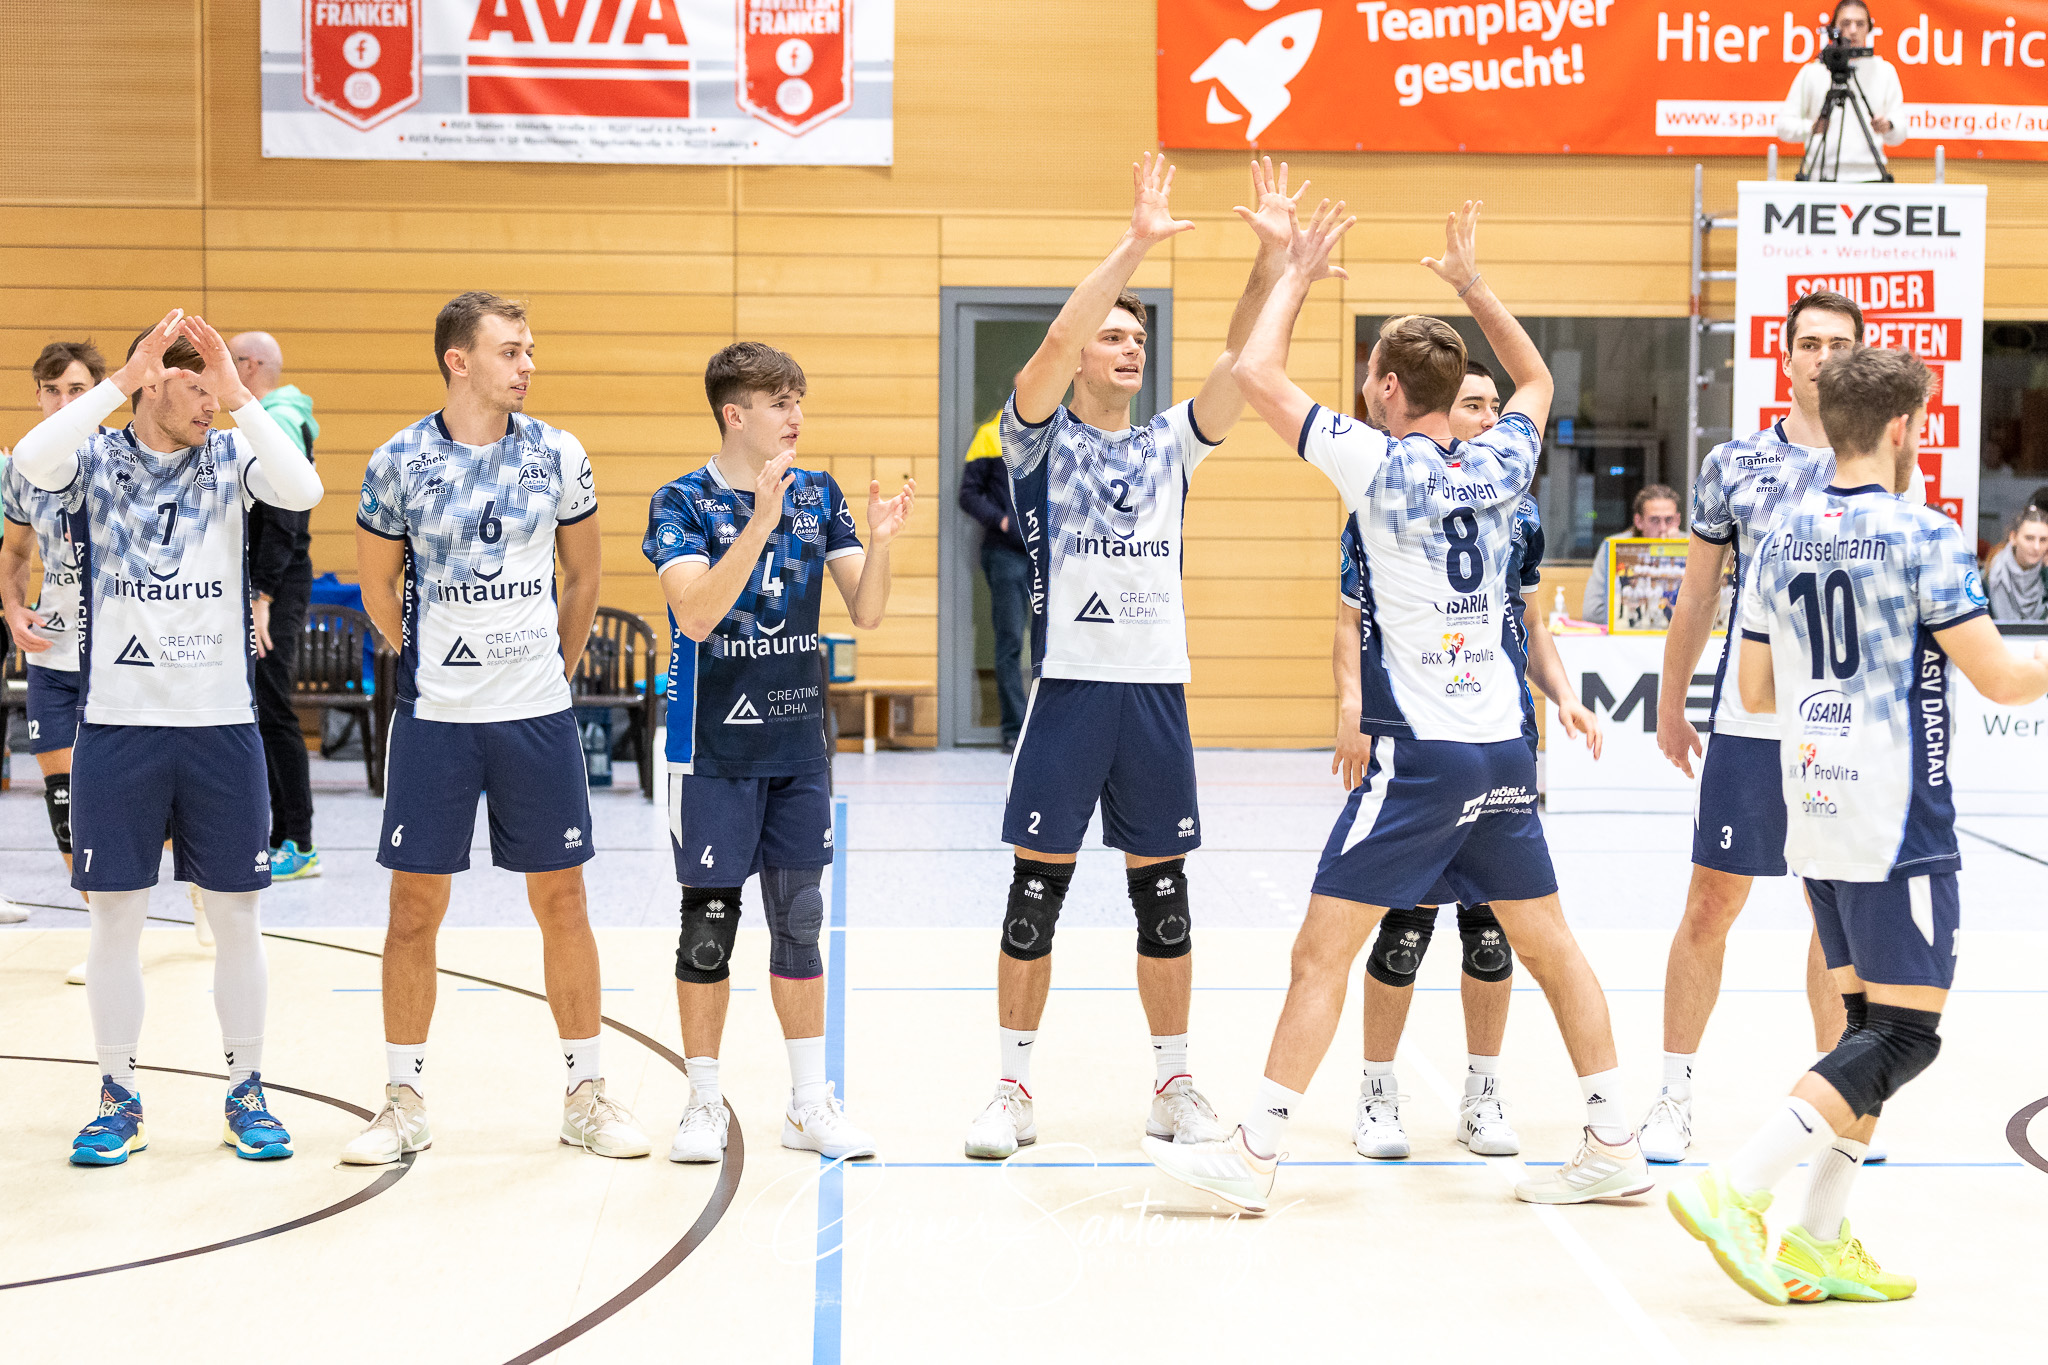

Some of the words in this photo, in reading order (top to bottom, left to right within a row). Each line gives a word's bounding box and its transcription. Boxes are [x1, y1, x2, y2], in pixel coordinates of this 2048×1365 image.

[315, 3, 408, 27] FRANKEN
[749, 10, 840, 34] FRANKEN
[1356, 0, 1615, 46] Teamplayer
[1657, 11, 1769, 63] Hier
[1897, 13, 1962, 66] du
[1981, 16, 2047, 68] ric
[1394, 43, 1586, 107] gesucht!
[1764, 203, 1961, 237] MEYSEL
[1763, 244, 1813, 258] Druck
[1837, 245, 1958, 261] Werbetechnik
[1110, 478, 1133, 513] 2
[157, 501, 178, 546] 7
[479, 500, 503, 545] 6
[1076, 531, 1170, 559] intaurus
[1443, 507, 1484, 593] 8
[1782, 534, 1887, 562] Russelmann
[761, 551, 785, 597] 4
[115, 572, 223, 602] intaurus
[437, 578, 543, 604] intaurus
[1120, 591, 1170, 604] CREATING
[1119, 606, 1158, 618] ALPHA
[486, 627, 548, 645] CREATING
[1788, 569, 1860, 680] 10
[159, 633, 223, 647] CREATING
[486, 645, 530, 659] ALPHA
[723, 632, 818, 659] intaurus
[160, 650, 206, 661] ALPHA
[1421, 652, 1443, 665] BKK
[1921, 649, 1942, 693] ASV
[767, 685, 819, 702] CREATING
[768, 702, 808, 716] ALPHA
[1807, 702, 1852, 723] ISARIA
[28, 720, 41, 740] 12
[1983, 714, 2045, 737] Wer
[1921, 698, 1945, 788] DACHAU
[1815, 763, 1859, 781] ProVita
[1027, 811, 1042, 835] 2
[391, 824, 404, 848] 6
[564, 839, 583, 849] errea
[1720, 825, 1733, 850] 3
[83, 848, 93, 873] 7
[700, 845, 715, 868] 4
[1024, 888, 1043, 900] errea
[1157, 886, 1176, 897] errea
[705, 911, 725, 919] errea
[1400, 938, 1417, 948] errea
[1481, 938, 1500, 946] errea
